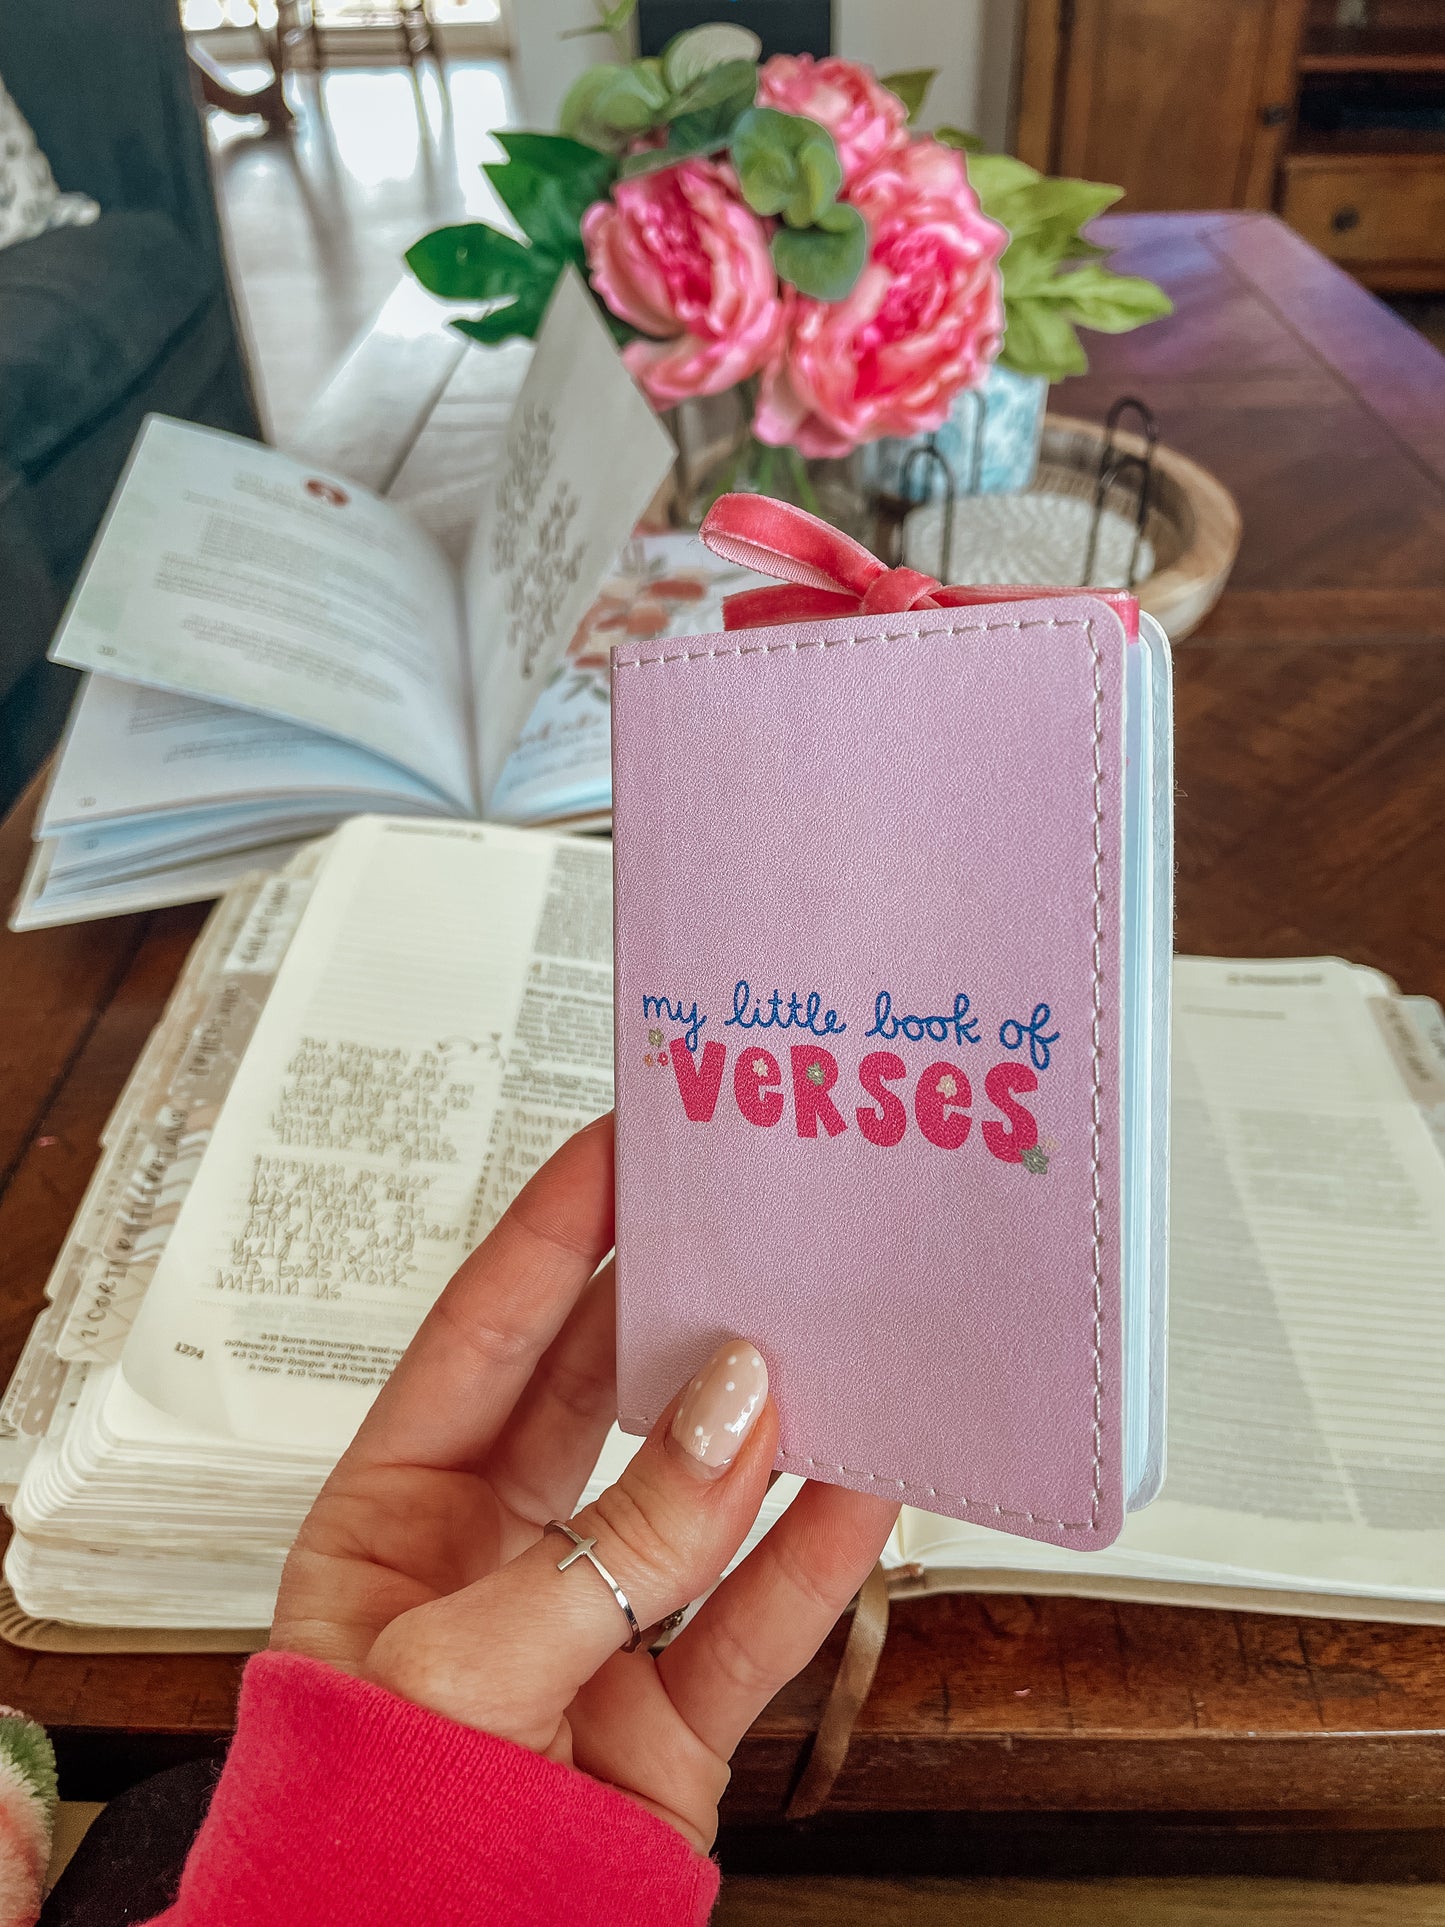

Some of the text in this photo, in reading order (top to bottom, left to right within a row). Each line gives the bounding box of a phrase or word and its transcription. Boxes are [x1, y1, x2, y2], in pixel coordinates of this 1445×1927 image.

[641, 994, 707, 1051] my
[722, 980, 847, 1036] little
[865, 990, 982, 1046] book
[999, 1003, 1060, 1070] of
